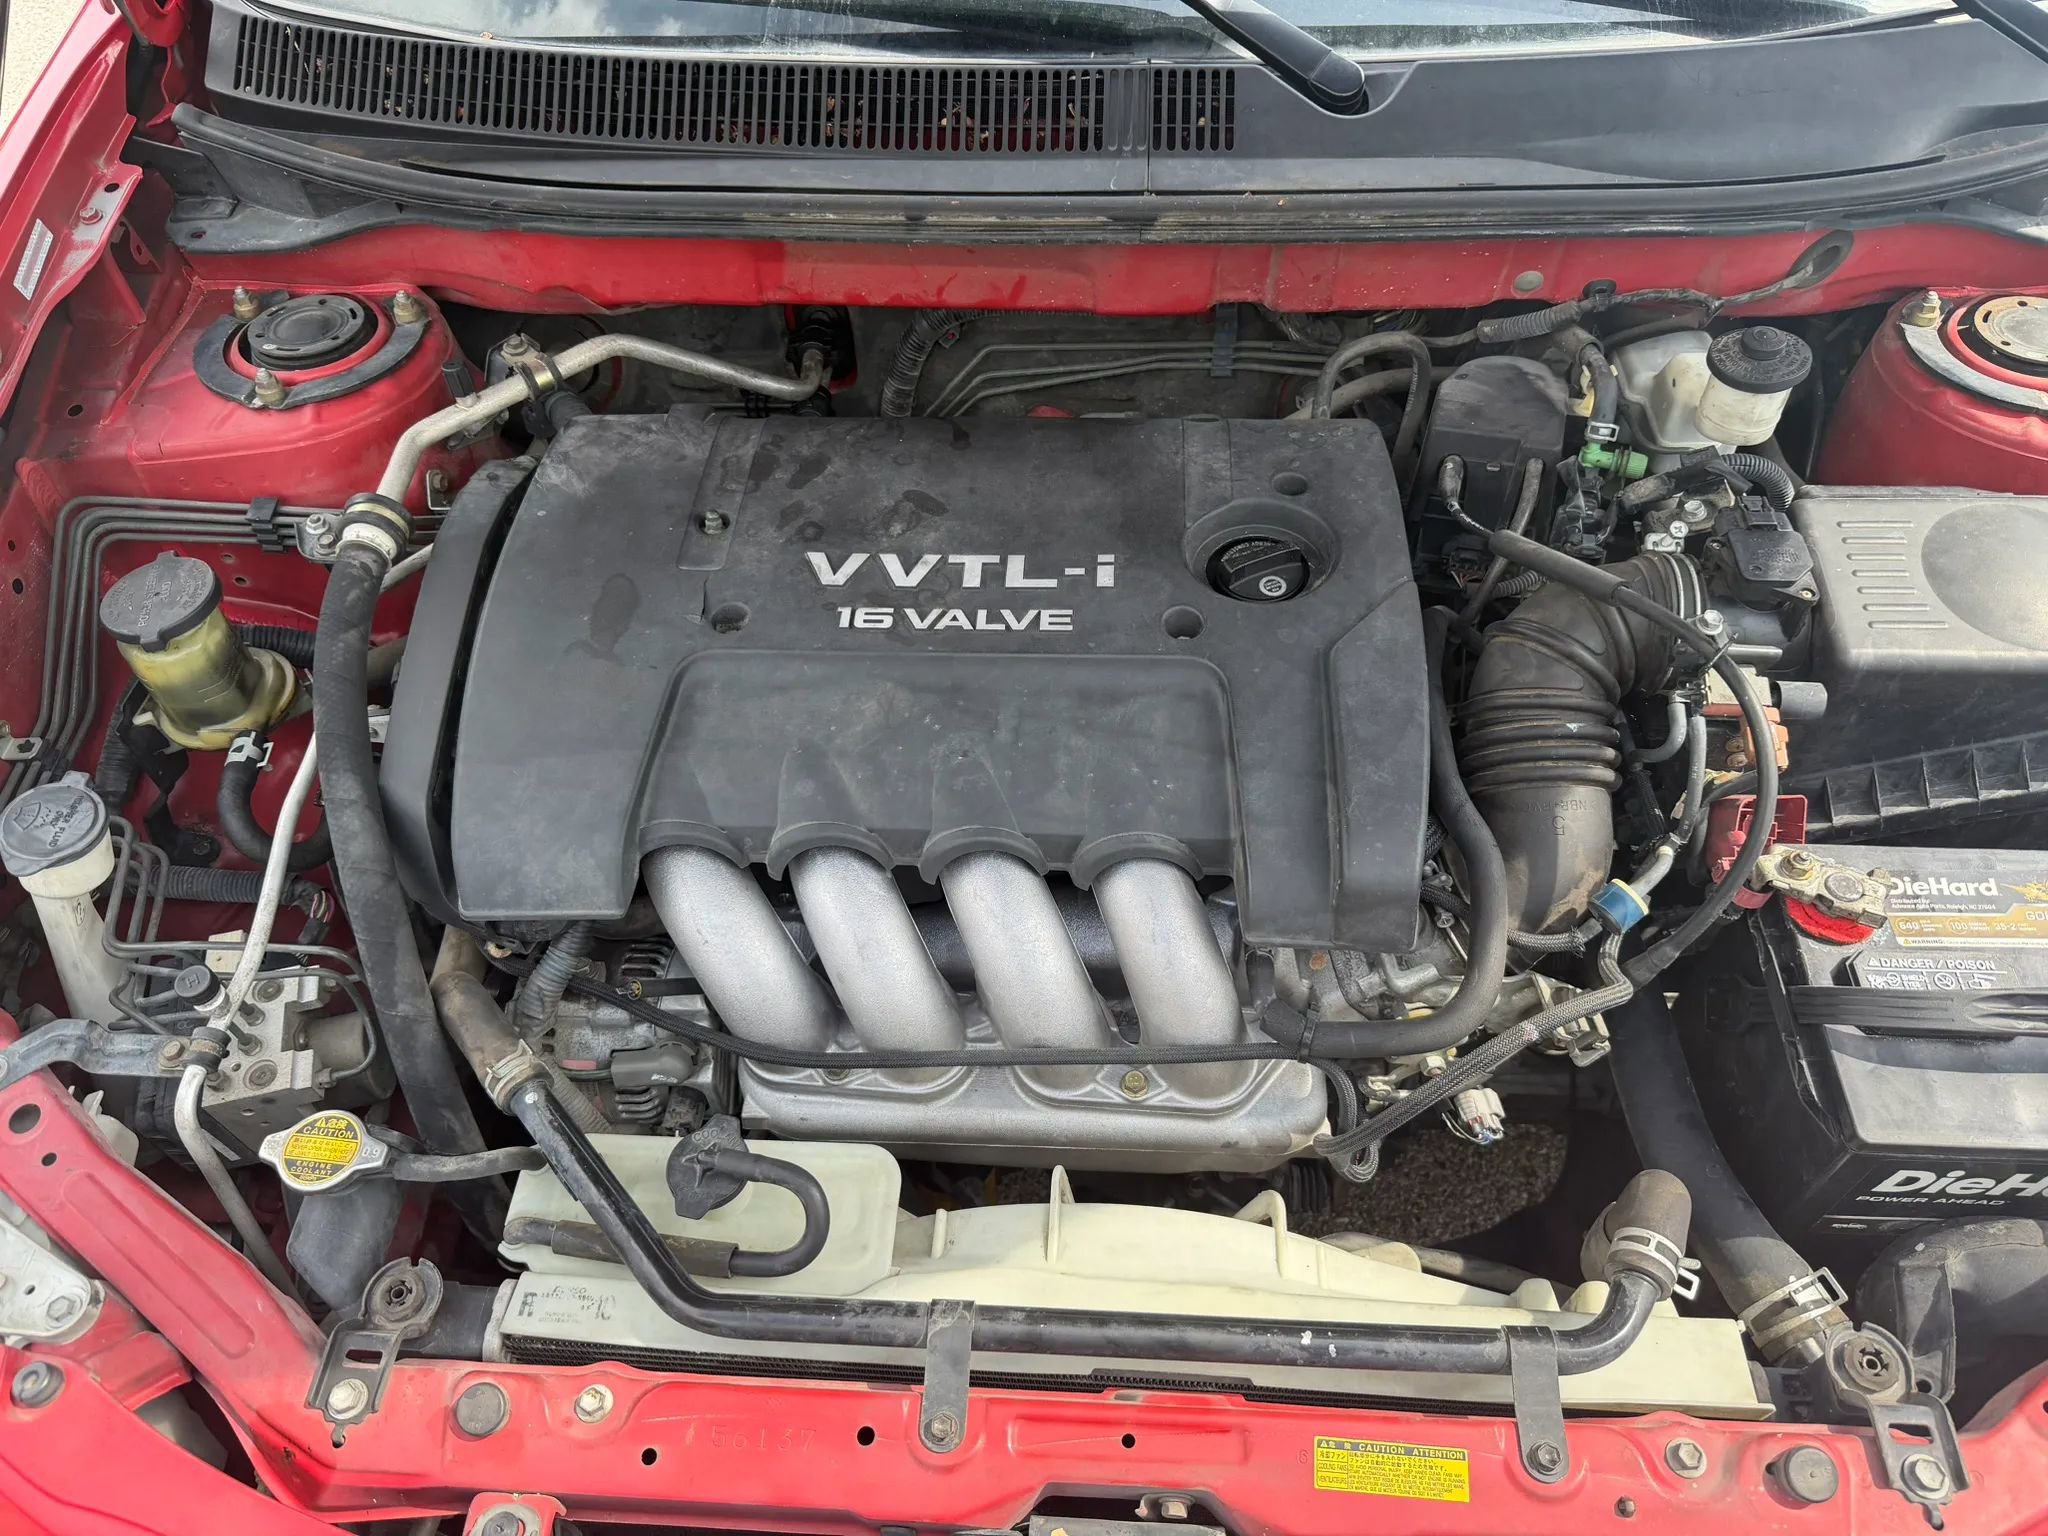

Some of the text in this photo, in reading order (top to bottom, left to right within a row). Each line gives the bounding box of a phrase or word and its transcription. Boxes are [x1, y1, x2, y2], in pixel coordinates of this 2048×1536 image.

[806, 552, 1115, 588] VVTL-i
[837, 607, 1073, 630] 16 VALVE
[1888, 877, 1998, 896] DieHard
[1950, 922, 1968, 930] 100
[1880, 958, 1934, 969] DANGER
[1946, 960, 1996, 970] POISON
[303, 1126, 355, 1139] CAUTION
[291, 1166, 333, 1176] COOLANT
[296, 1160, 333, 1170] ENGINE
[1871, 1169, 2048, 1197] DieH
[1855, 1195, 2005, 1206] POWER AHEAD
[1358, 1443, 1464, 1459] CAUTION ATTENTION
